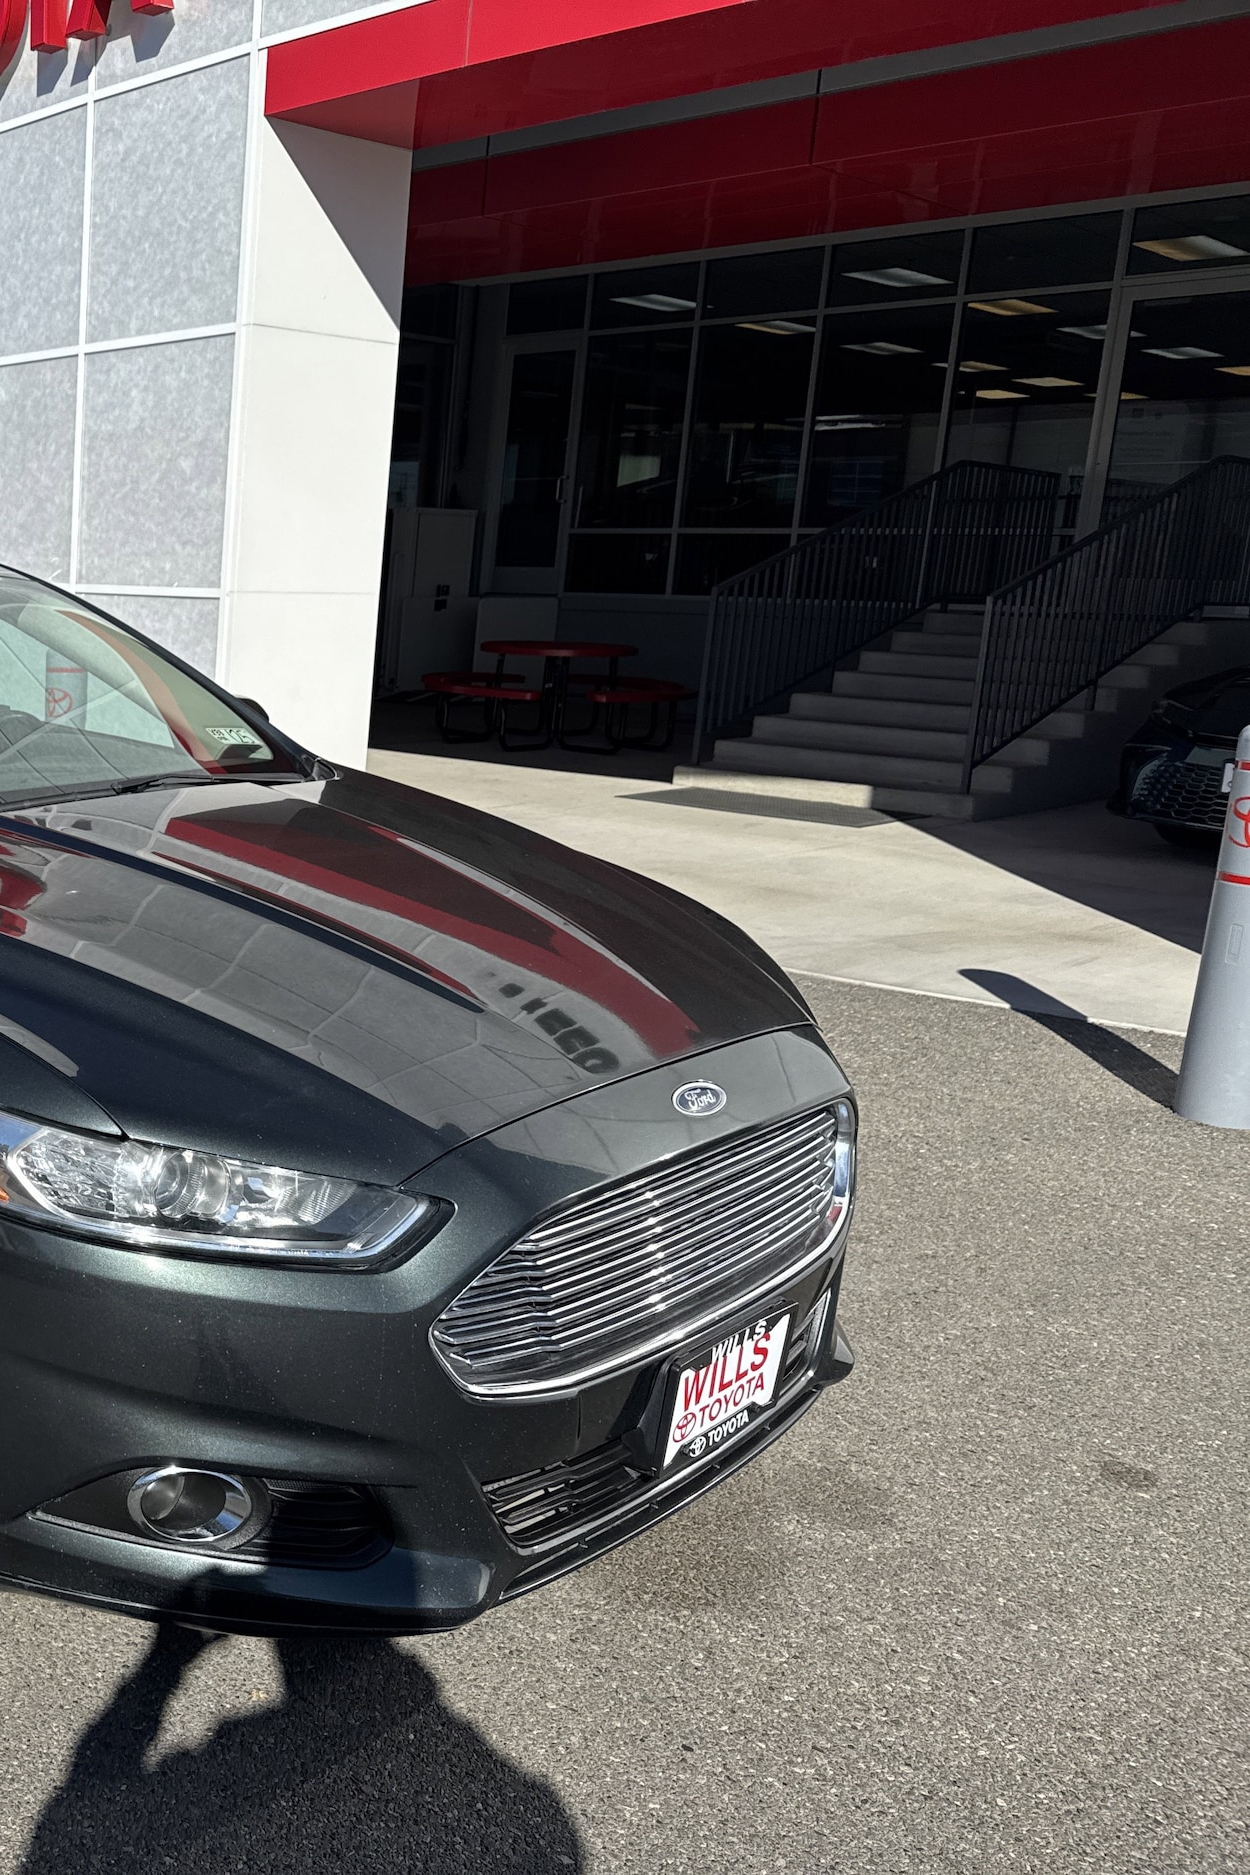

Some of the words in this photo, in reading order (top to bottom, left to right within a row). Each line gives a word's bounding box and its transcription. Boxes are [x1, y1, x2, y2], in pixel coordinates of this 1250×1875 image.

[684, 1088, 716, 1111] Ford
[712, 1320, 766, 1361] WILLS
[684, 1333, 770, 1411] WILLS
[700, 1372, 764, 1427] TOYOTA
[708, 1410, 749, 1445] TOYOTA
